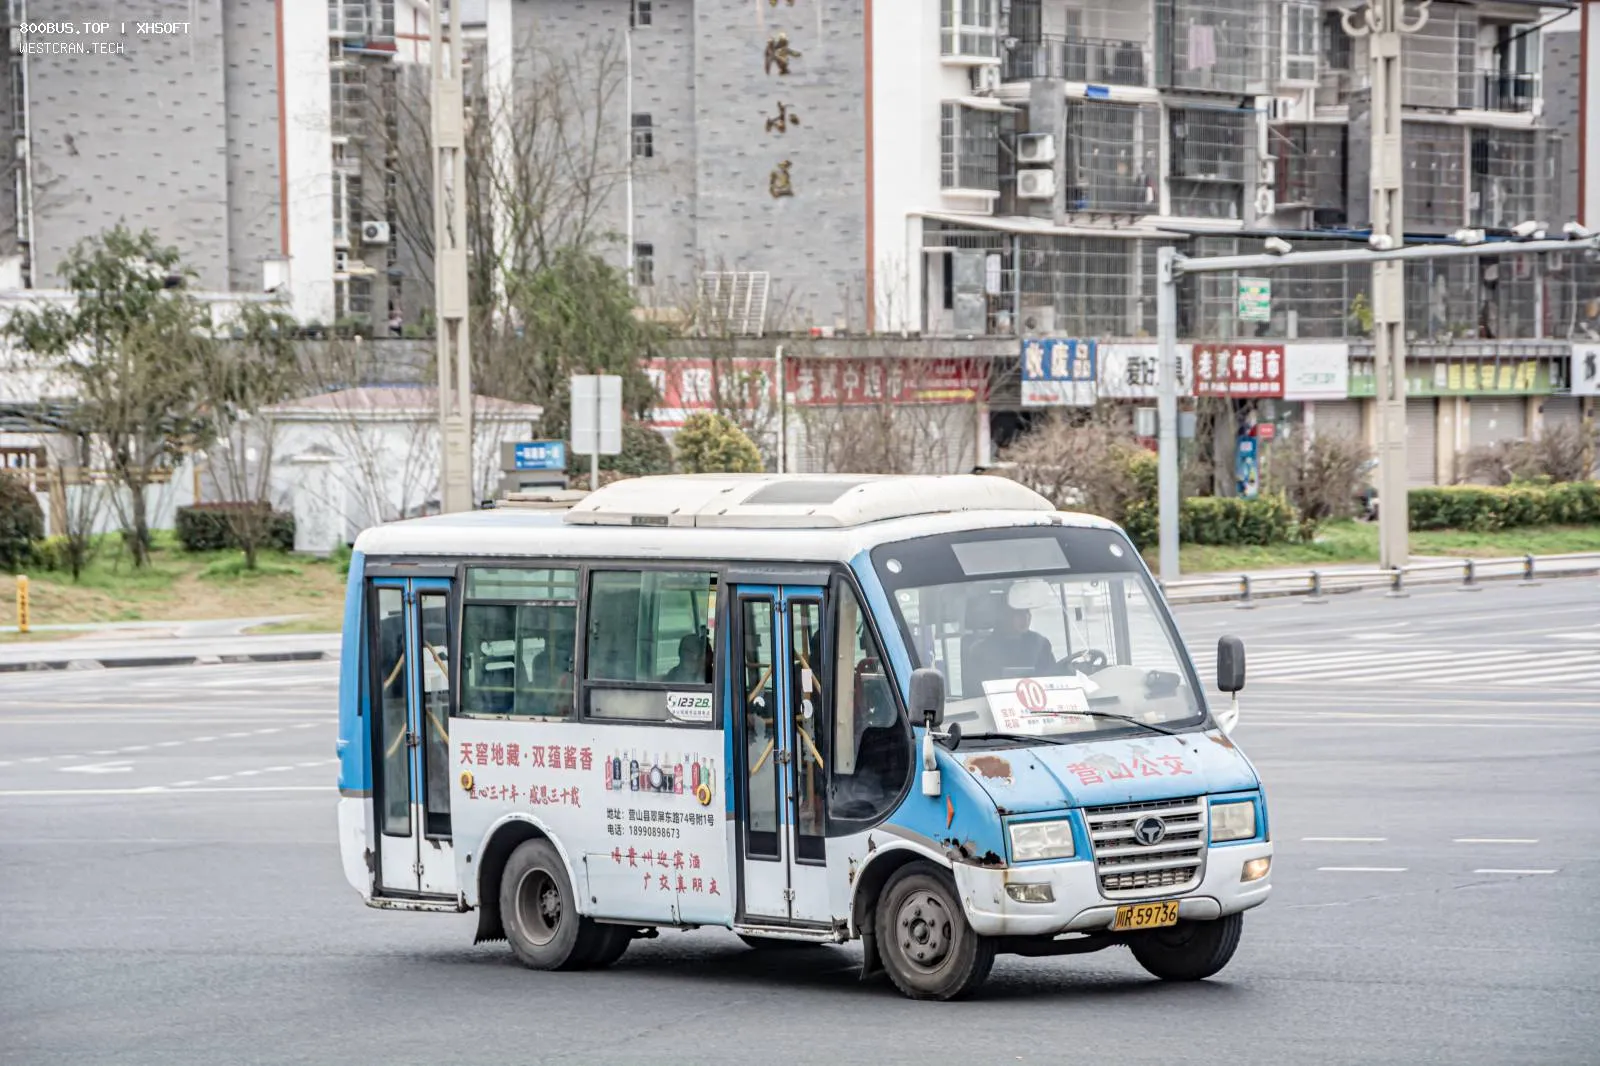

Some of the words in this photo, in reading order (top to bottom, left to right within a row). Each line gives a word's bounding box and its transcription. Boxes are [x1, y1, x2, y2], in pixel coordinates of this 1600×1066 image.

[678, 697, 710, 708] 12328
[1020, 682, 1045, 708] 10
[1066, 752, 1193, 785] 营山公交
[643, 872, 721, 896] 广交真朋友
